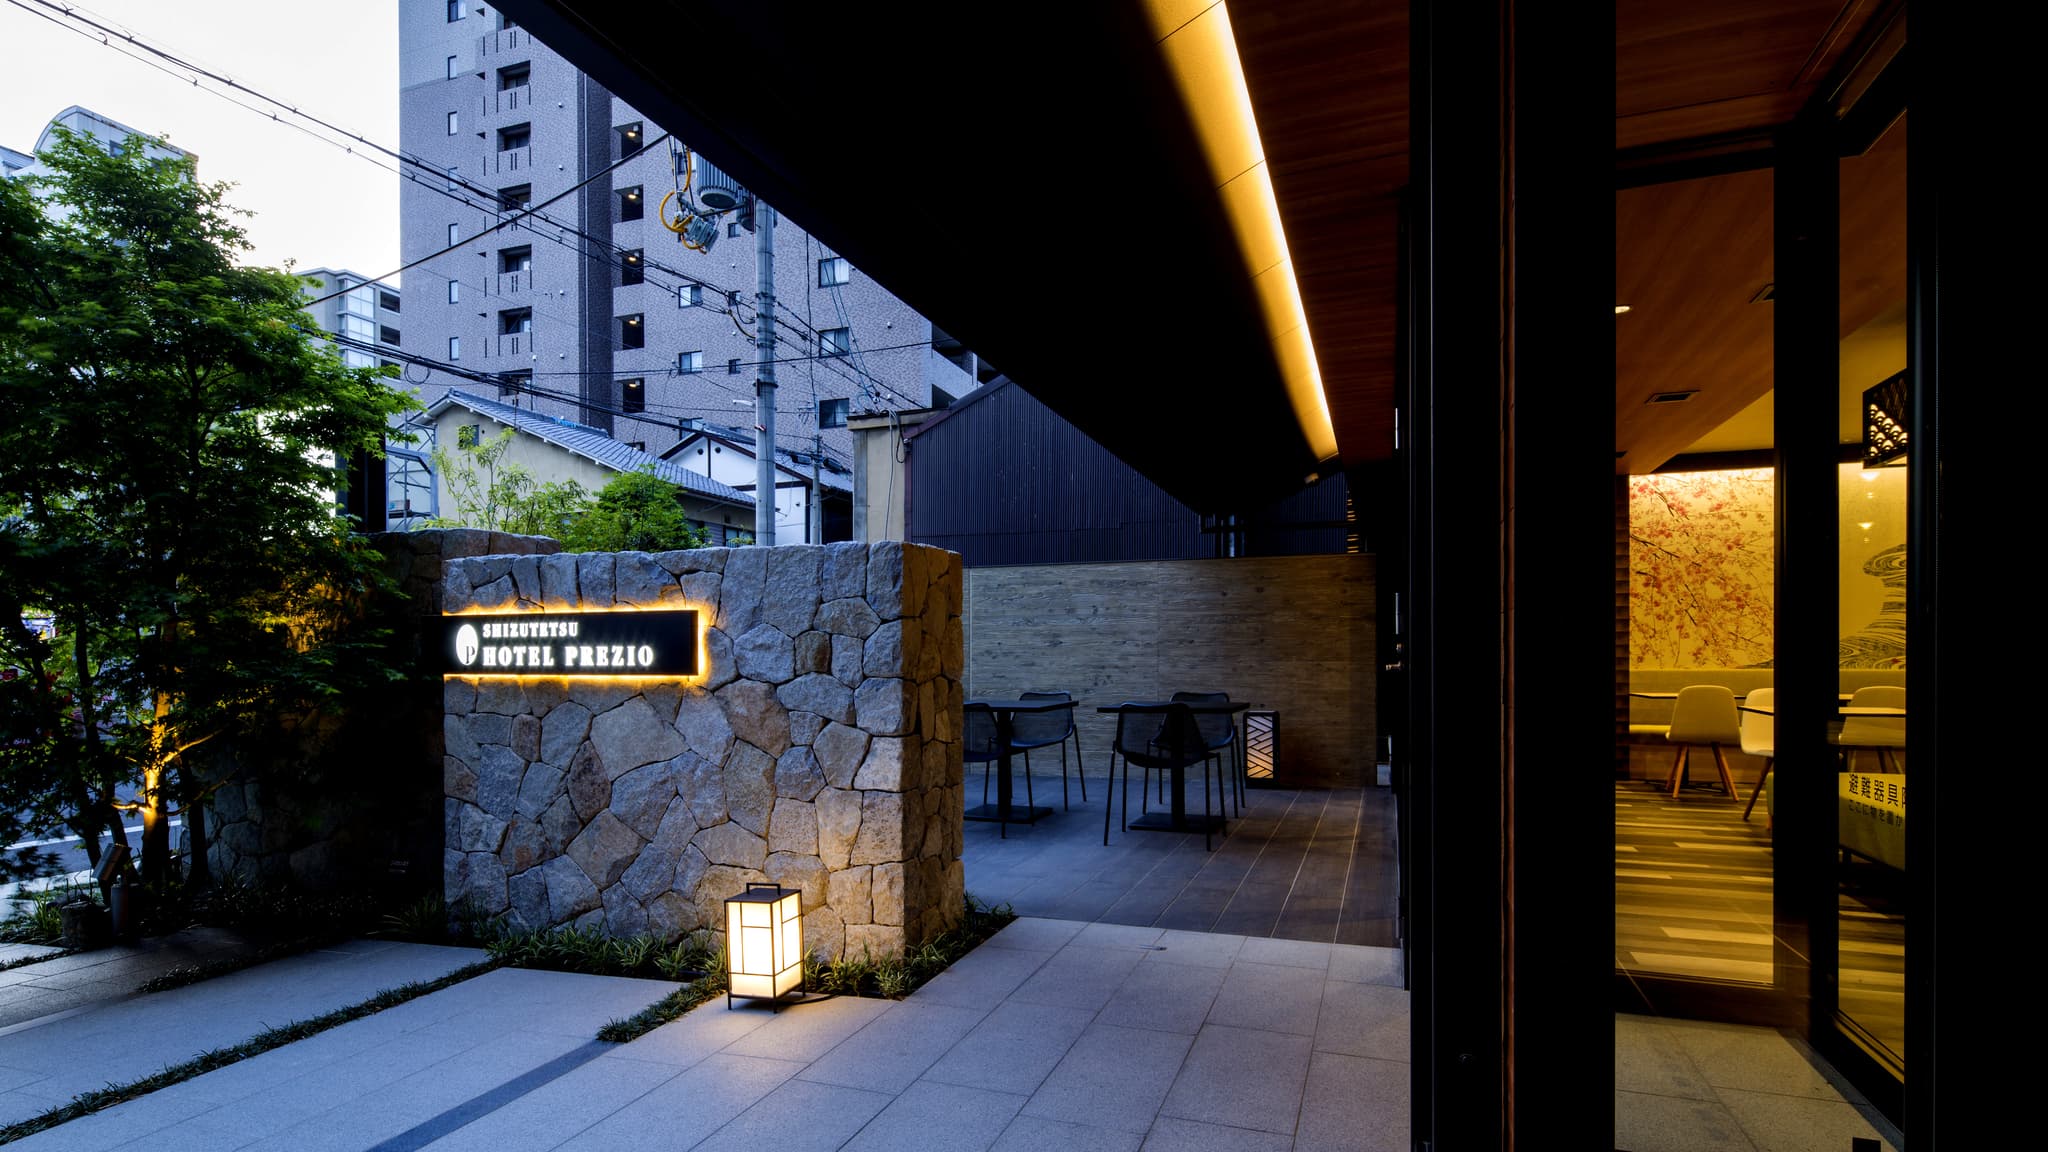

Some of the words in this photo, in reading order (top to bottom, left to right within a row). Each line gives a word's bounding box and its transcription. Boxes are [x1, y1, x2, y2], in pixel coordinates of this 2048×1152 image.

[482, 622, 579, 638] SHIZUTETSU
[482, 646, 554, 667] HOTEL
[565, 645, 654, 667] PREZIO
